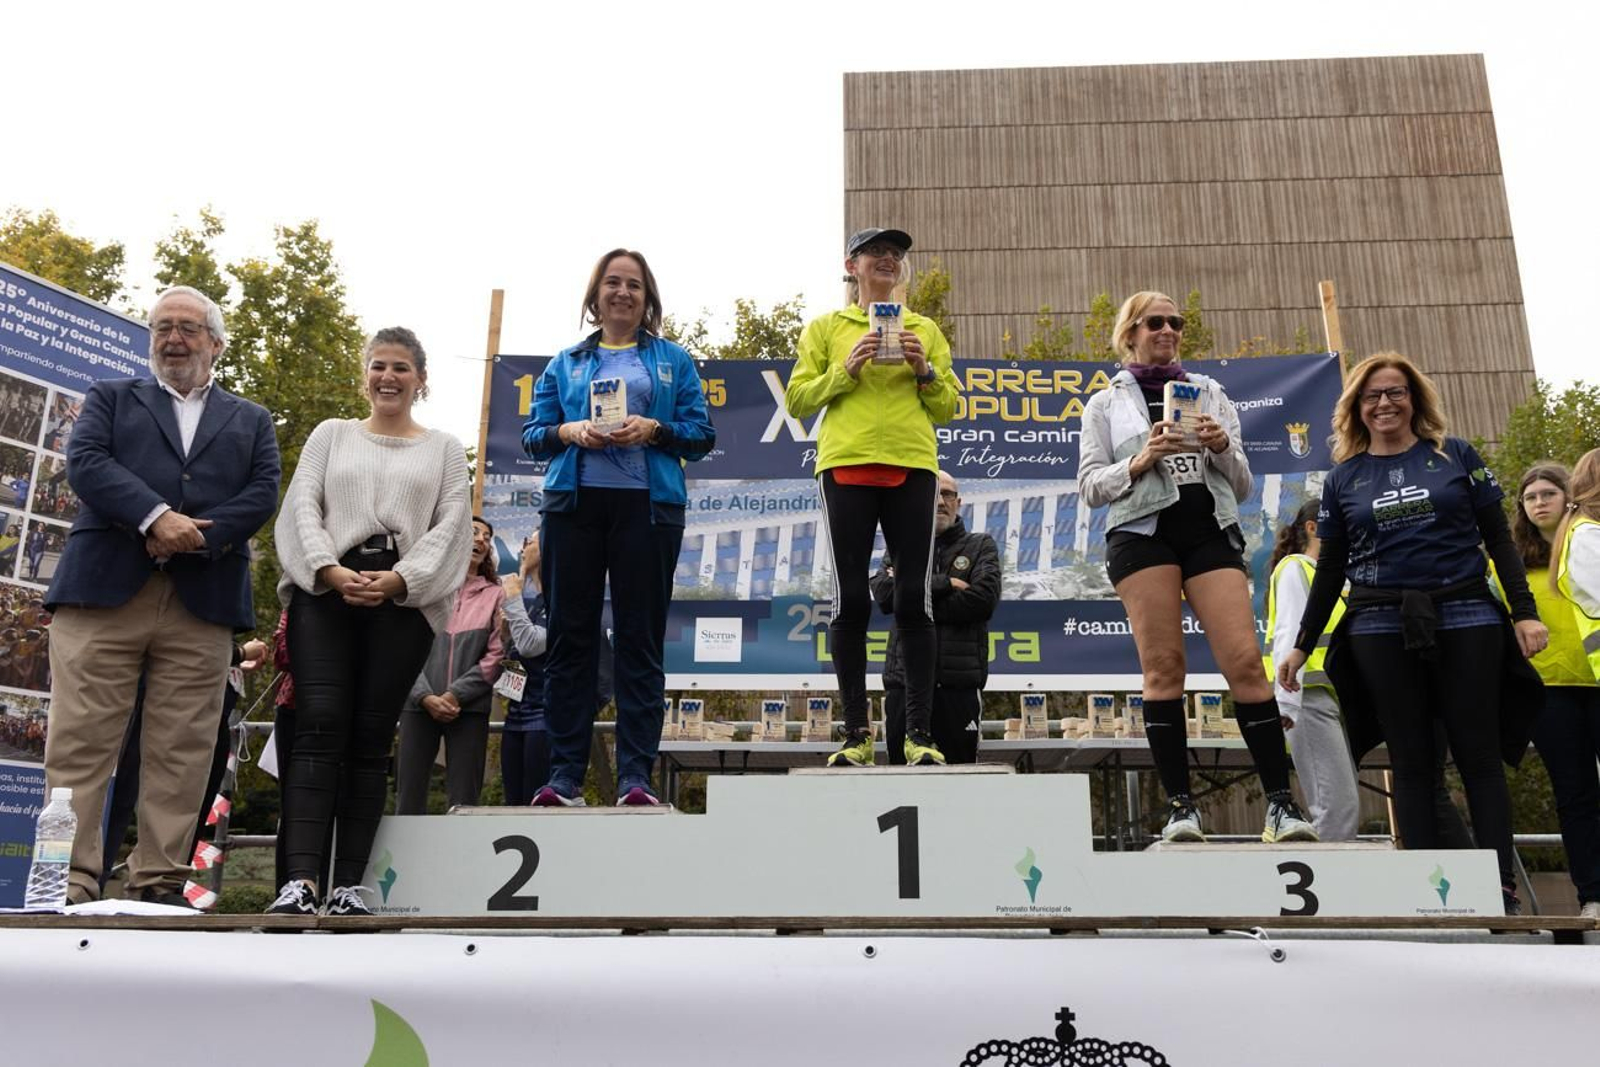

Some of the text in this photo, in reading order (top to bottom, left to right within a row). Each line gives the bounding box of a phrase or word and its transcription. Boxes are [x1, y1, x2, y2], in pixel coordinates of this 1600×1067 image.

[27, 296, 100, 332] Aniversario
[103, 324, 117, 340] de
[118, 331, 131, 344] la
[874, 304, 901, 317] XXV
[1, 318, 136, 377] la Paz y la Integración
[6, 304, 59, 332] Popular
[60, 326, 69, 338] y
[69, 329, 100, 348] Gran
[102, 341, 148, 366] Camina
[592, 379, 620, 396] XXV
[1173, 384, 1201, 400] XXV
[936, 427, 995, 444] gran
[956, 443, 1069, 478] Integración
[510, 491, 542, 508] IES
[699, 495, 722, 511] de
[1372, 485, 1430, 508] 25
[876, 805, 921, 899] 1
[487, 835, 541, 911] 2
[1276, 861, 1320, 917] 3
[996, 905, 1072, 914] Patronato Municipal de
